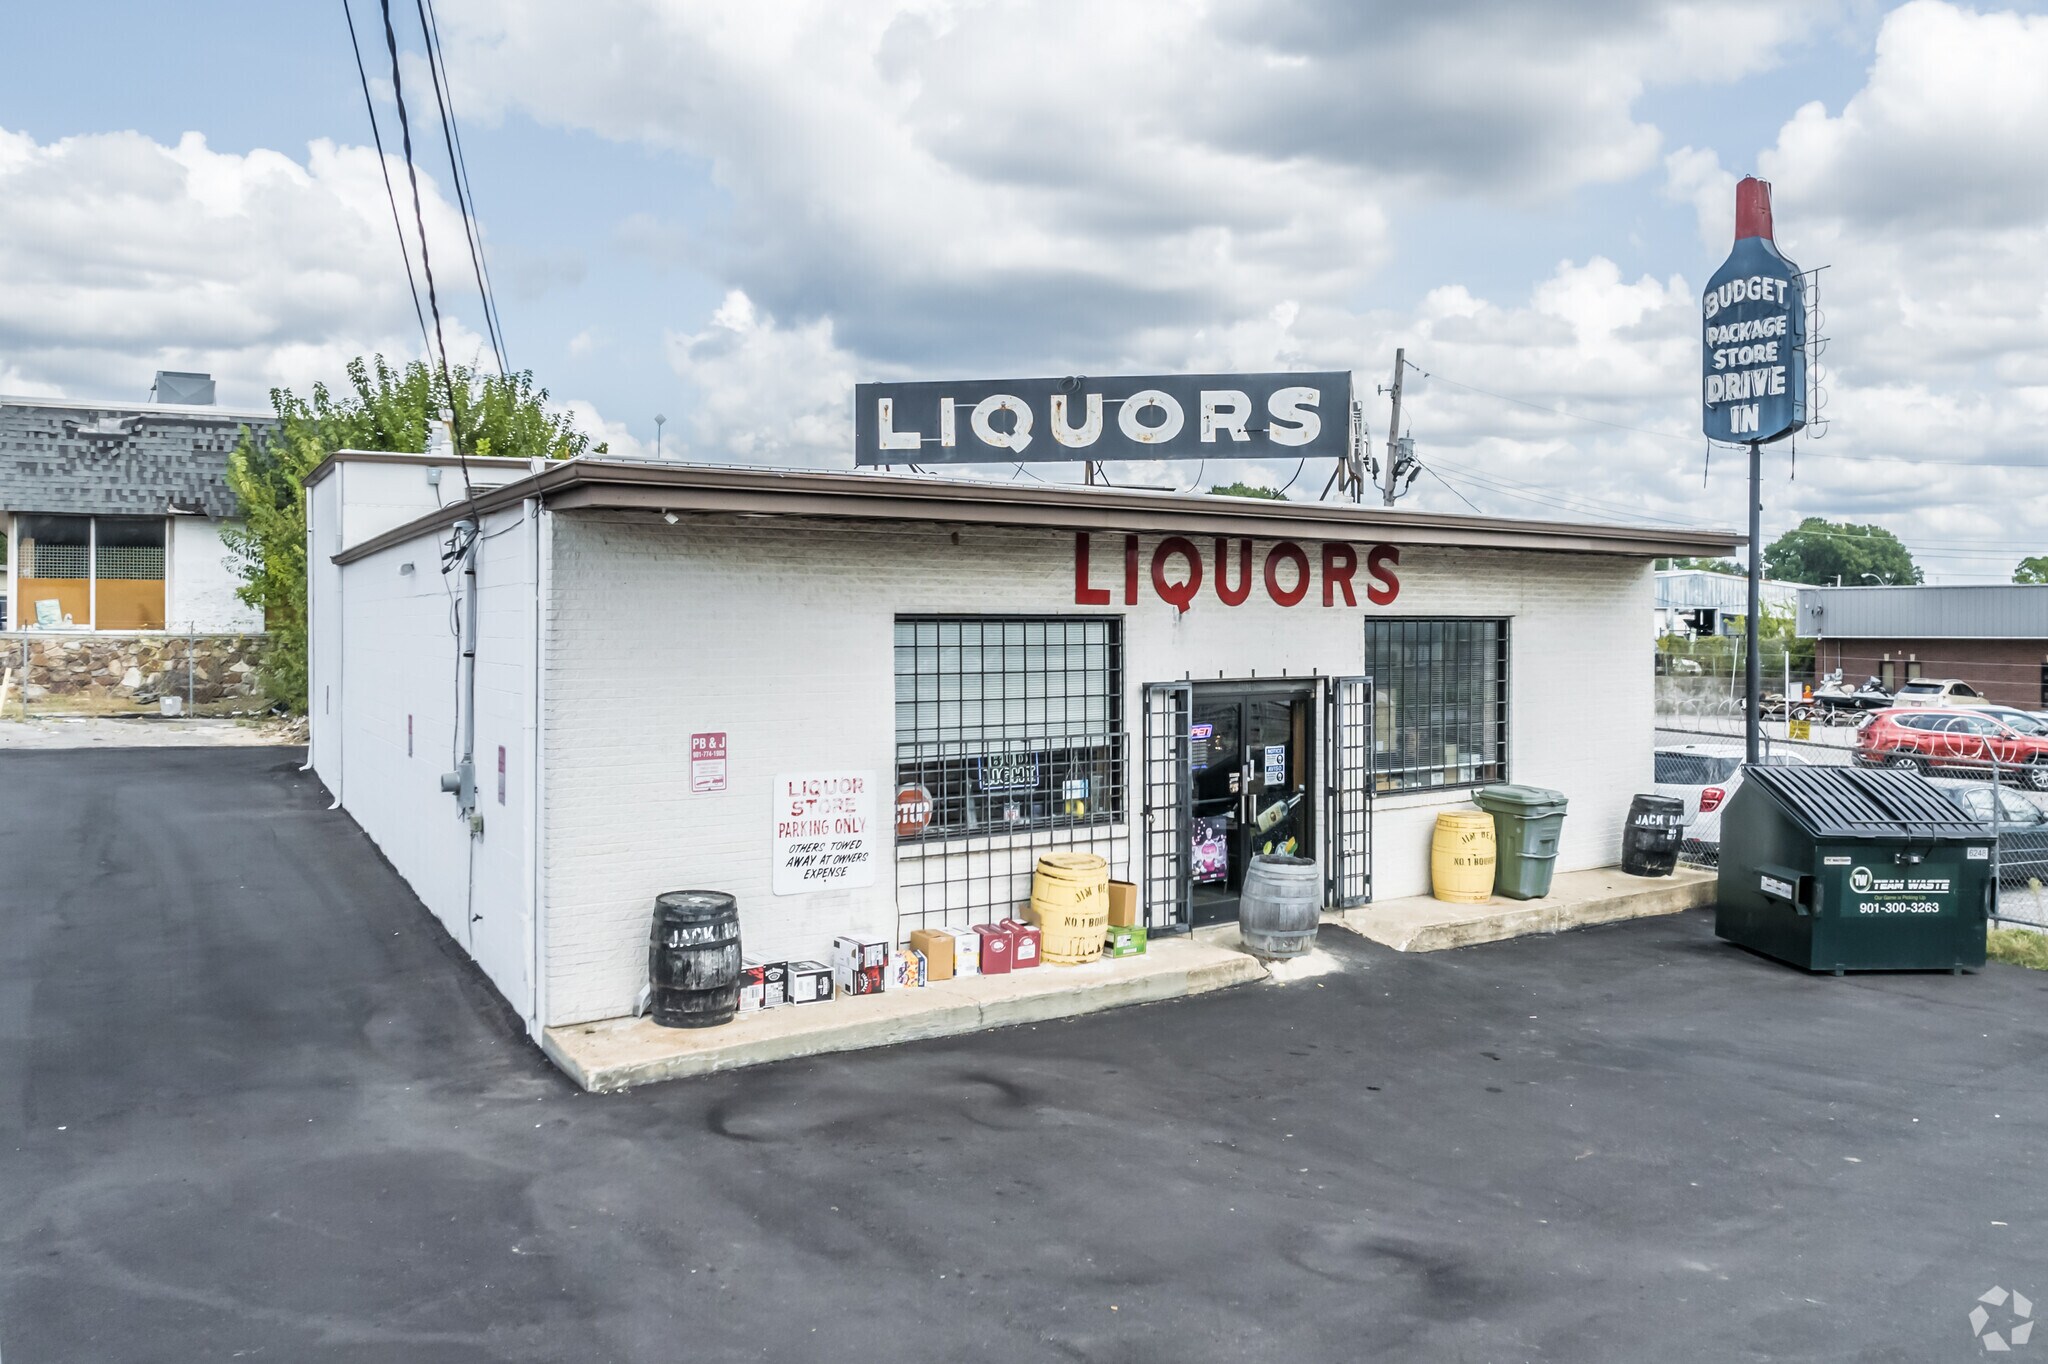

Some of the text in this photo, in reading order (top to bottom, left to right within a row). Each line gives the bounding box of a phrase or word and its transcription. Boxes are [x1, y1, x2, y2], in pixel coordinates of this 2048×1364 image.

[1704, 275, 1788, 319] BUDGET
[1706, 315, 1787, 348] PACKAGE
[1711, 344, 1778, 370] STORE
[1705, 366, 1786, 403] DRIVE
[878, 386, 1321, 454] LIQUORS
[1730, 404, 1759, 434] IN
[1075, 532, 1401, 614] LIQUORS
[693, 737, 725, 750] PB & J
[788, 777, 865, 797] LIQUOR
[791, 797, 857, 816] STORE
[778, 817, 866, 838] PARKING ONLY
[1635, 814, 1664, 826] JACK
[789, 839, 862, 854] OTHERS TOWED
[1968, 848, 1987, 858] 6248
[786, 852, 869, 868] AWAY AT OWNERS
[803, 866, 848, 880] EXPENSE
[1854, 874, 1868, 887] TW
[1873, 879, 1950, 890] TEAM WASTE
[1075, 887, 1092, 903] JIM
[1860, 902, 1940, 914] 901-300-3263
[668, 925, 716, 949] JACK
